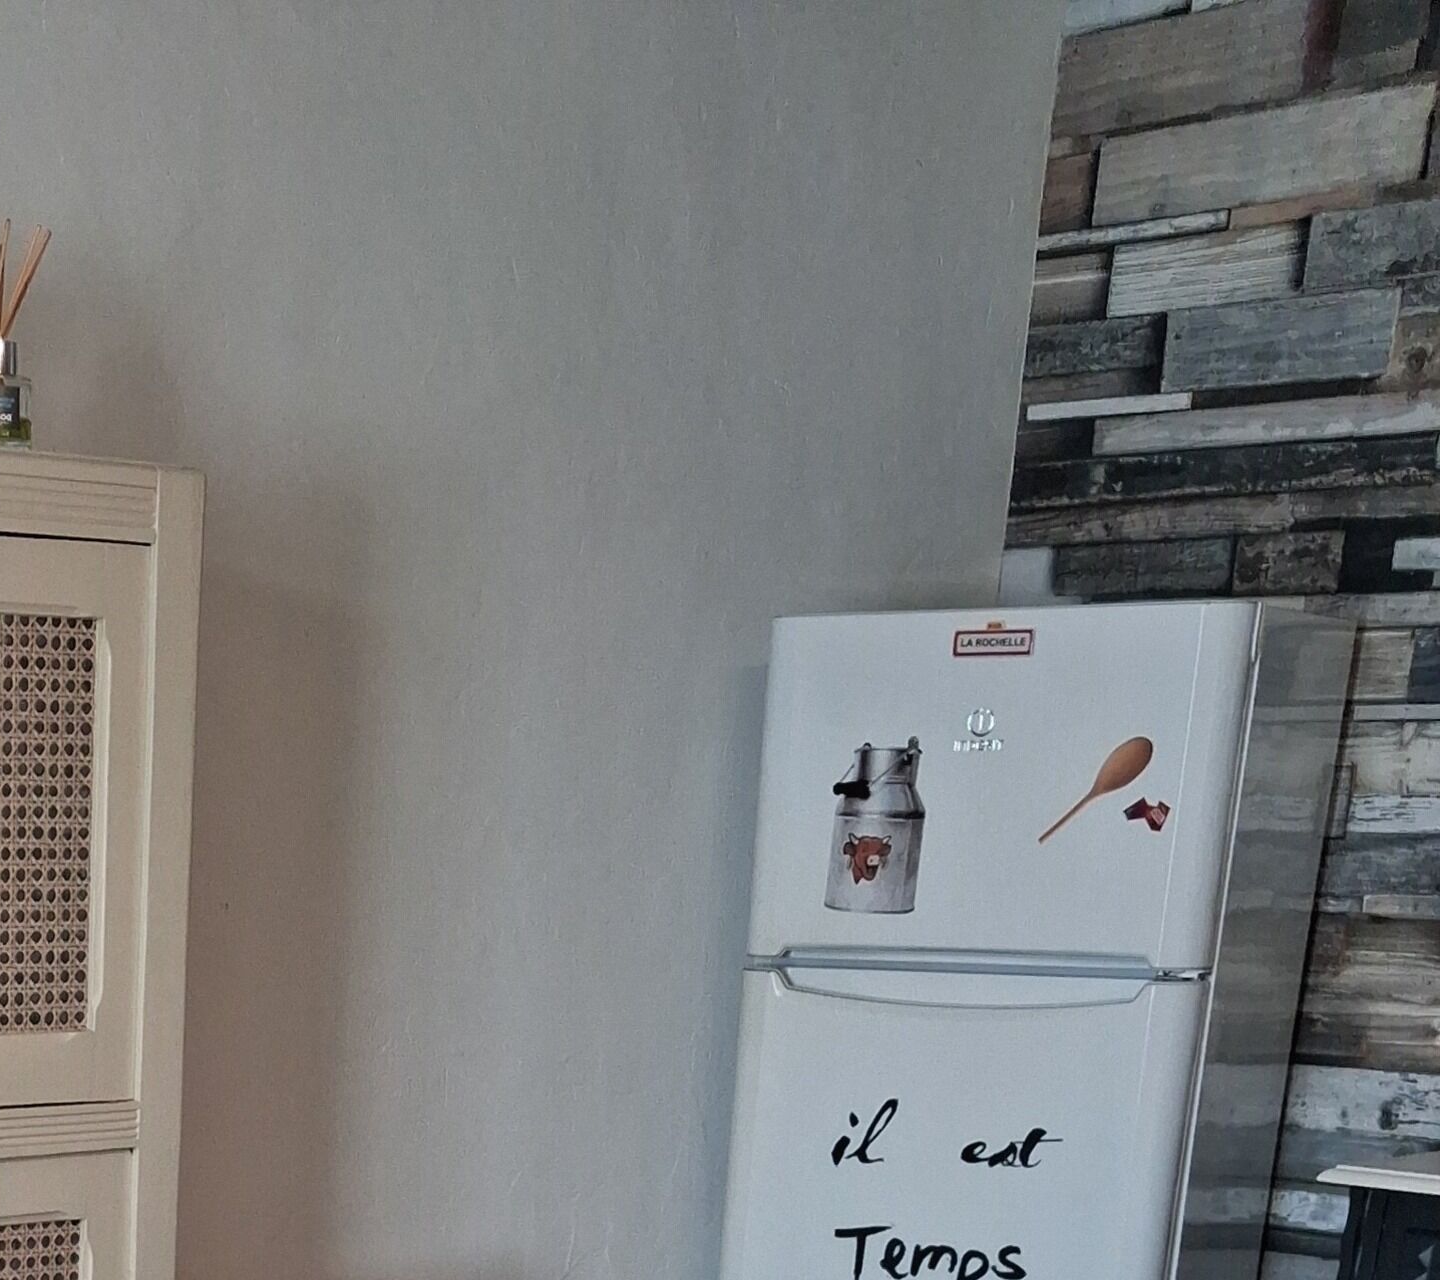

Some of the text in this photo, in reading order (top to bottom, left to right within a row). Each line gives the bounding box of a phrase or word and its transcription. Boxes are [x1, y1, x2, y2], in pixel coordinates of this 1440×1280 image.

[960, 636, 1027, 648] LA ROCHELLE
[832, 1099, 1062, 1168] il est
